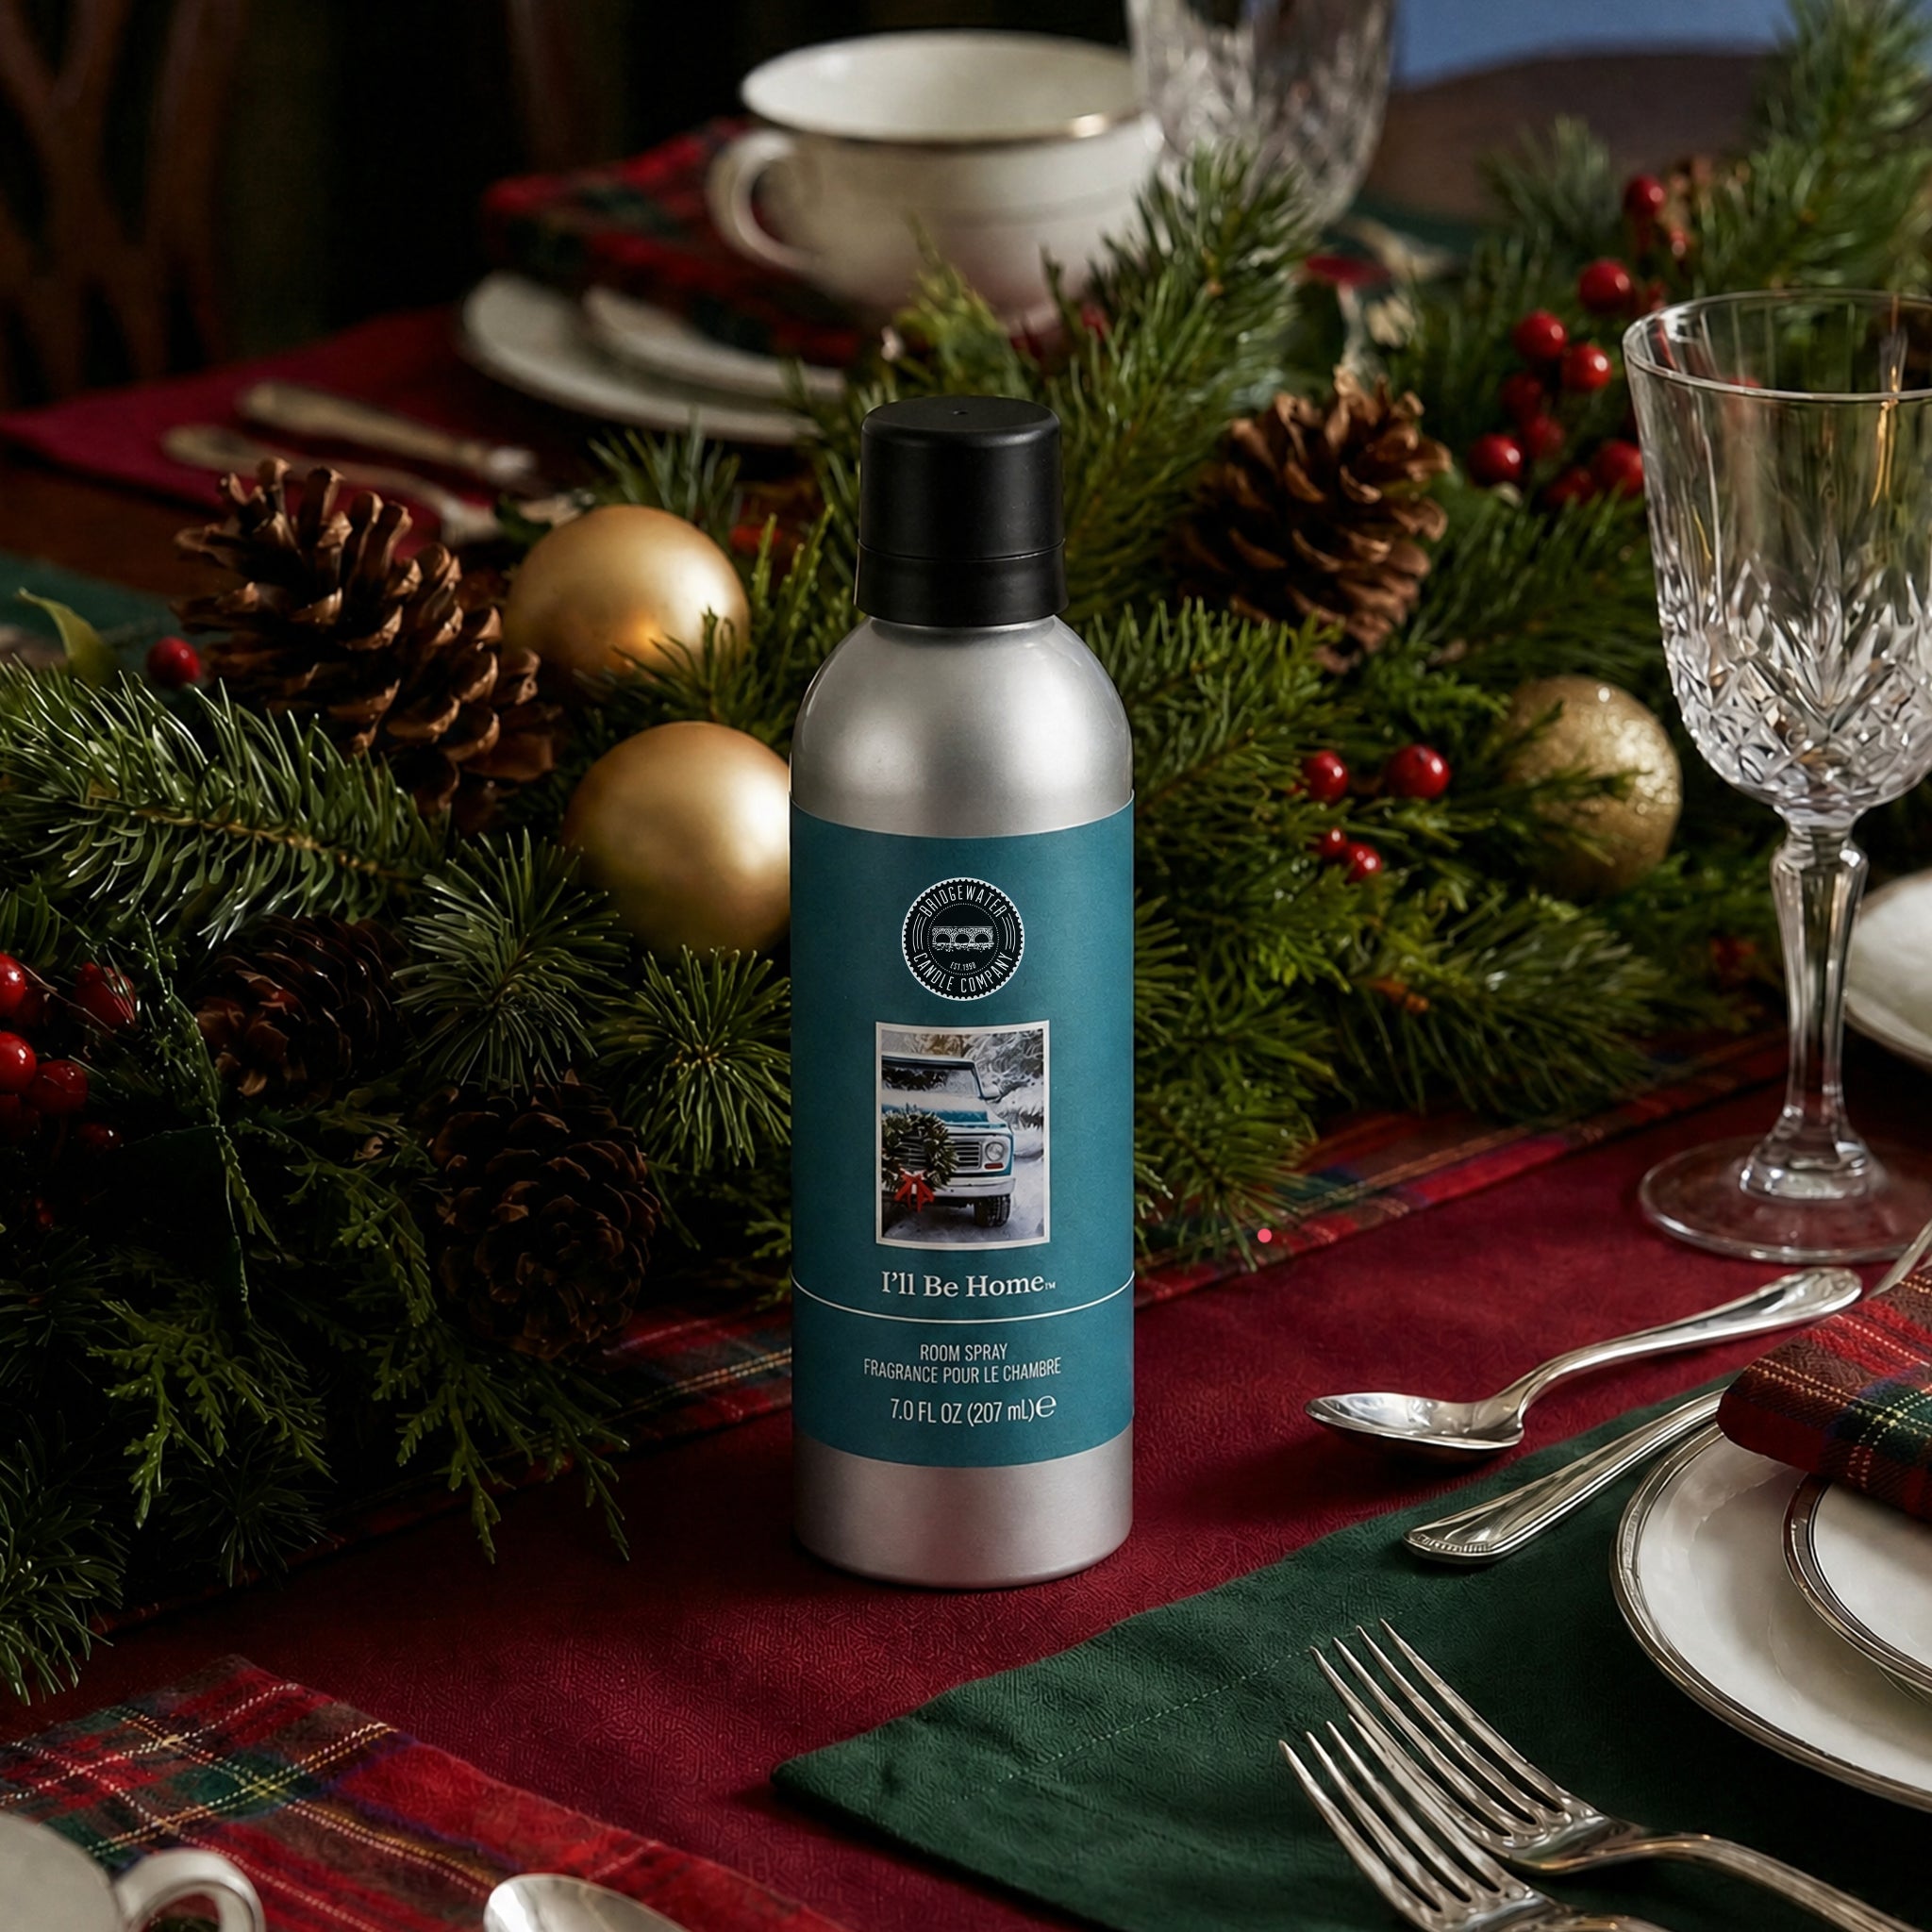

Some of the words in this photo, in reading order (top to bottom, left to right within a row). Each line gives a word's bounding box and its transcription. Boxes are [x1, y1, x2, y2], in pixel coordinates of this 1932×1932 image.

[919, 885, 1008, 918] BRIDGEWATER
[913, 952, 955, 991] CANDLE
[960, 951, 1013, 993] COMPANY
[923, 1275, 959, 1298] Be
[920, 1343, 960, 1362] ROOM
[964, 1342, 1008, 1362] SPRAY
[863, 1357, 939, 1384] FRAGRANCE
[942, 1366, 980, 1385] POUR
[984, 1365, 999, 1384] LE
[1003, 1357, 1062, 1383] CHAMBRE
[890, 1398, 914, 1422] 7.0
[918, 1401, 937, 1424] FL
[941, 1402, 963, 1424] OZ
[967, 1402, 1003, 1427] (207
